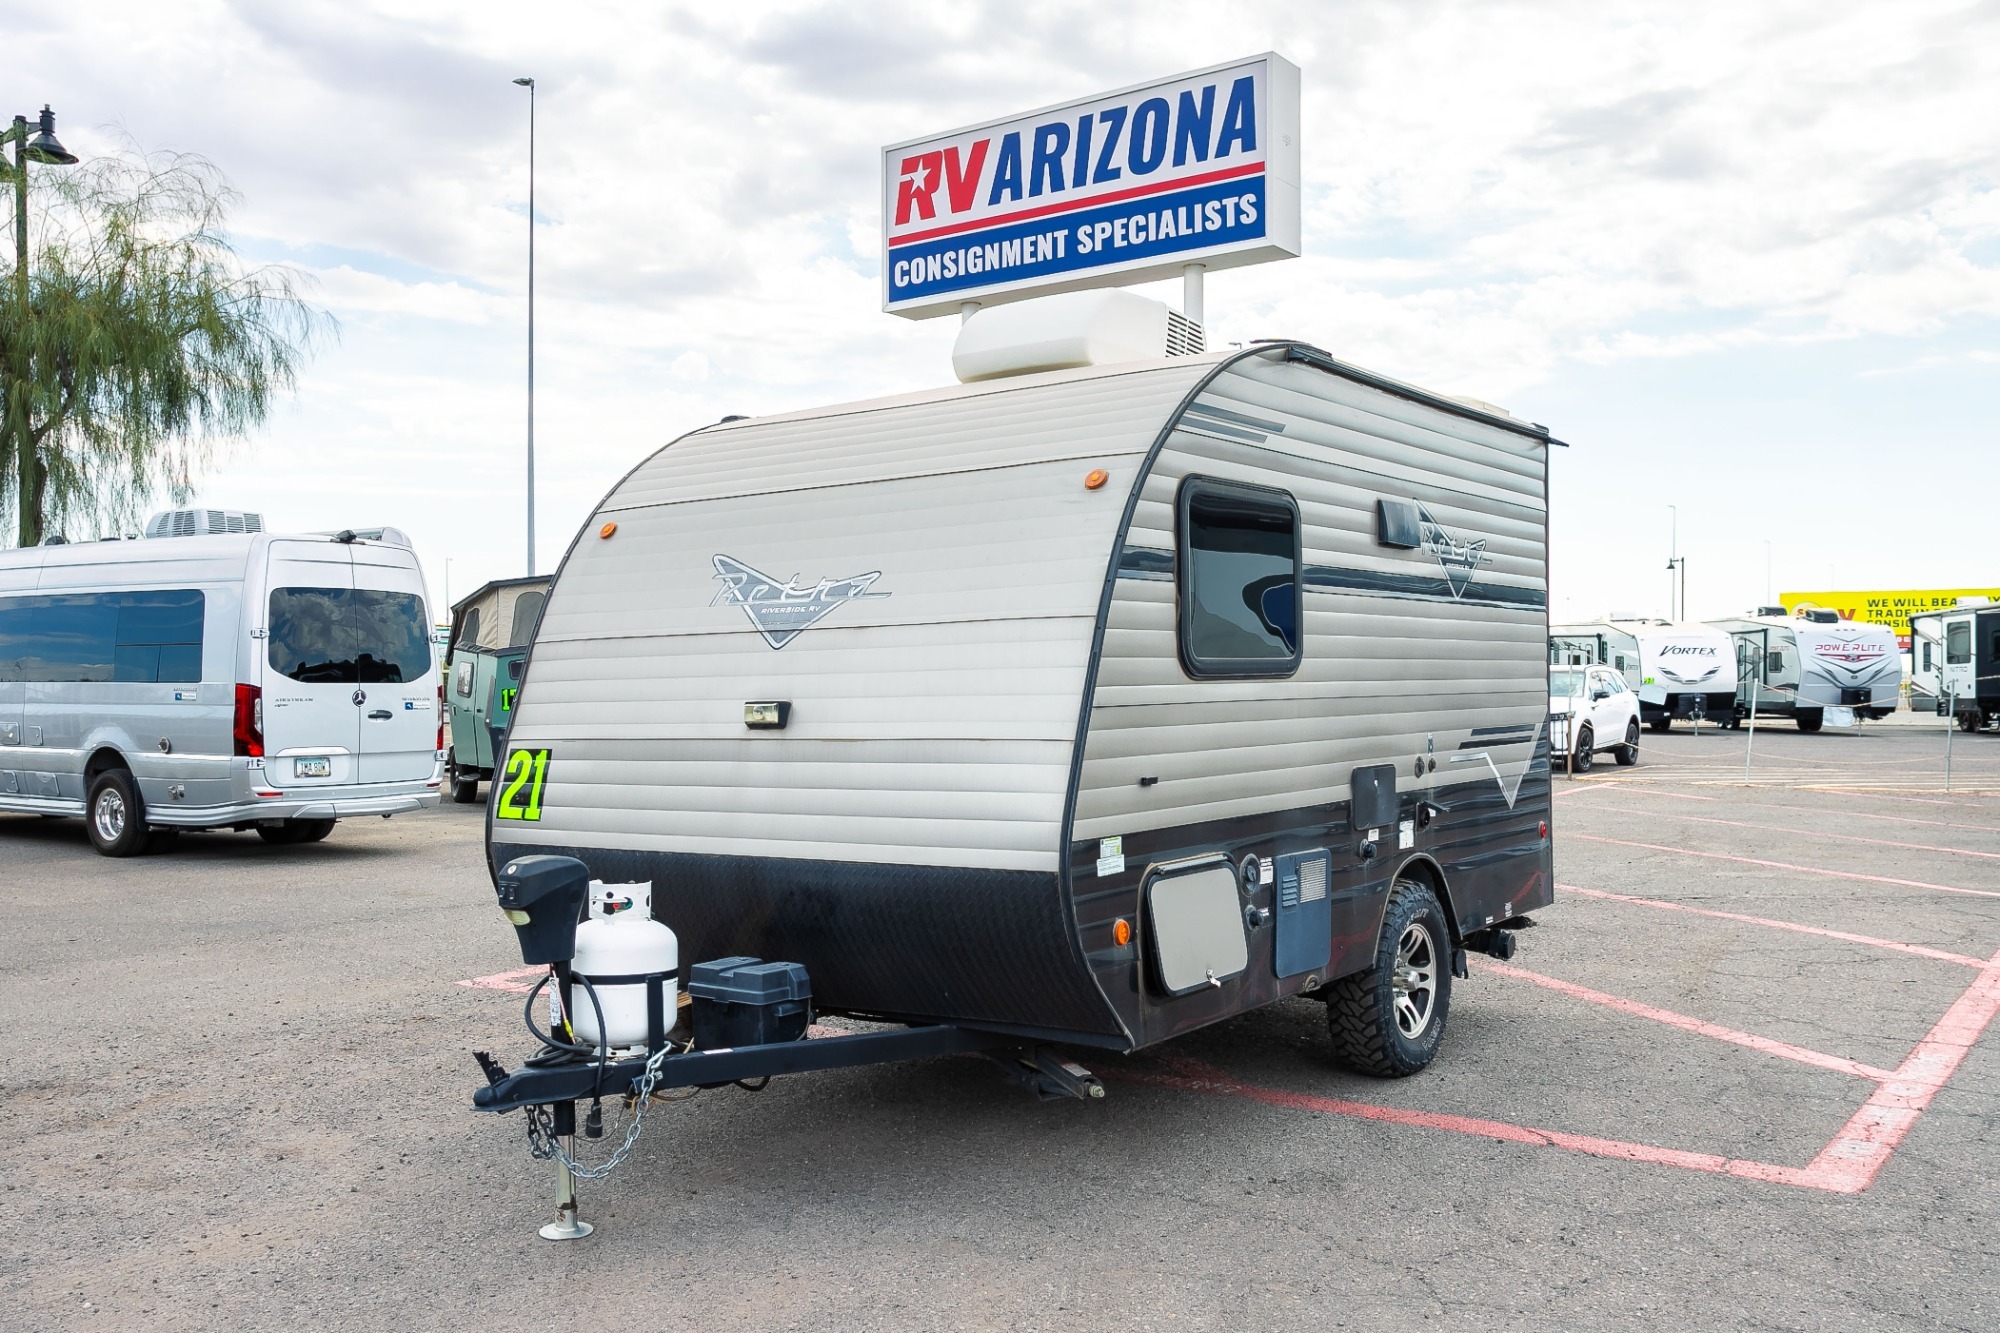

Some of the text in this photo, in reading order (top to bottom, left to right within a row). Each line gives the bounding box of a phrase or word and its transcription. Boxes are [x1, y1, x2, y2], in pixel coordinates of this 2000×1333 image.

[895, 77, 1257, 226] RV ARIZONA
[895, 194, 1258, 288] CONSIGNMENT SPECIALISTS
[708, 572, 892, 607] Retro
[1867, 597, 1957, 607] WE WILL BEA
[761, 606, 806, 614] RIVERSIDE
[1866, 609, 1912, 618] TRADE
[1866, 619, 1912, 628] ONSIG
[1659, 645, 1717, 657] VORTEX
[1814, 644, 1886, 652] POWERLITE
[499, 749, 548, 820] 21
